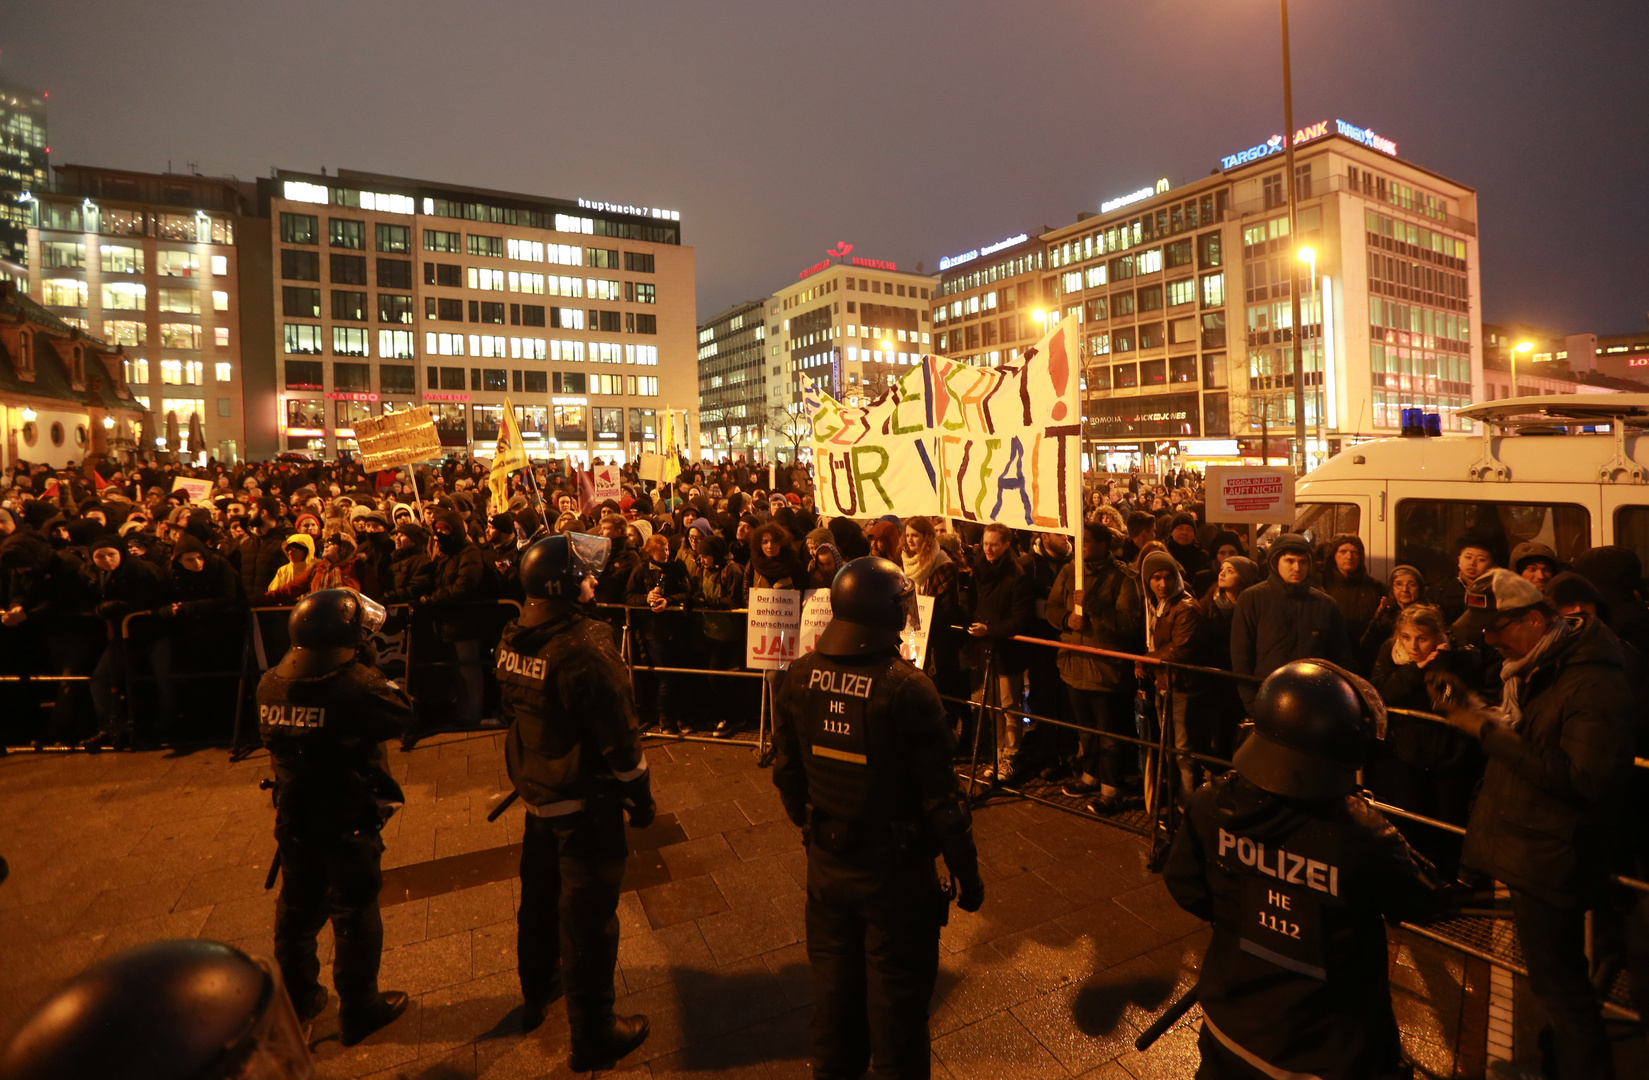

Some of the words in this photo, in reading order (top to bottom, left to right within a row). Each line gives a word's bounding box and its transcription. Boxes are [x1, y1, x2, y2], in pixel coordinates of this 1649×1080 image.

[1221, 143, 1268, 170] TARGO
[852, 256, 897, 271] HALLESCHE
[1629, 358, 1649, 367] LO
[325, 392, 379, 402] MAREDO
[422, 393, 471, 402] MAREDO
[817, 445, 894, 516] FÜR
[914, 423, 1081, 529] VIELFALT
[1224, 486, 1250, 495] LÄUFT
[1252, 484, 1282, 494] NICHT!
[544, 580, 562, 595] 11
[772, 596, 793, 604] Islam
[756, 608, 782, 616] gehört
[810, 607, 833, 616] gehör
[750, 620, 799, 629] Deutschland
[752, 635, 795, 656] JA!
[496, 650, 547, 680] POLIZEI
[809, 669, 873, 699] POLIZEI
[829, 701, 845, 714] HE
[260, 704, 325, 728] POLIZEI
[823, 719, 850, 736] 1112
[1218, 827, 1338, 897] POLIZEI
[1268, 889, 1291, 911] HE
[1258, 911, 1301, 940] 1112
